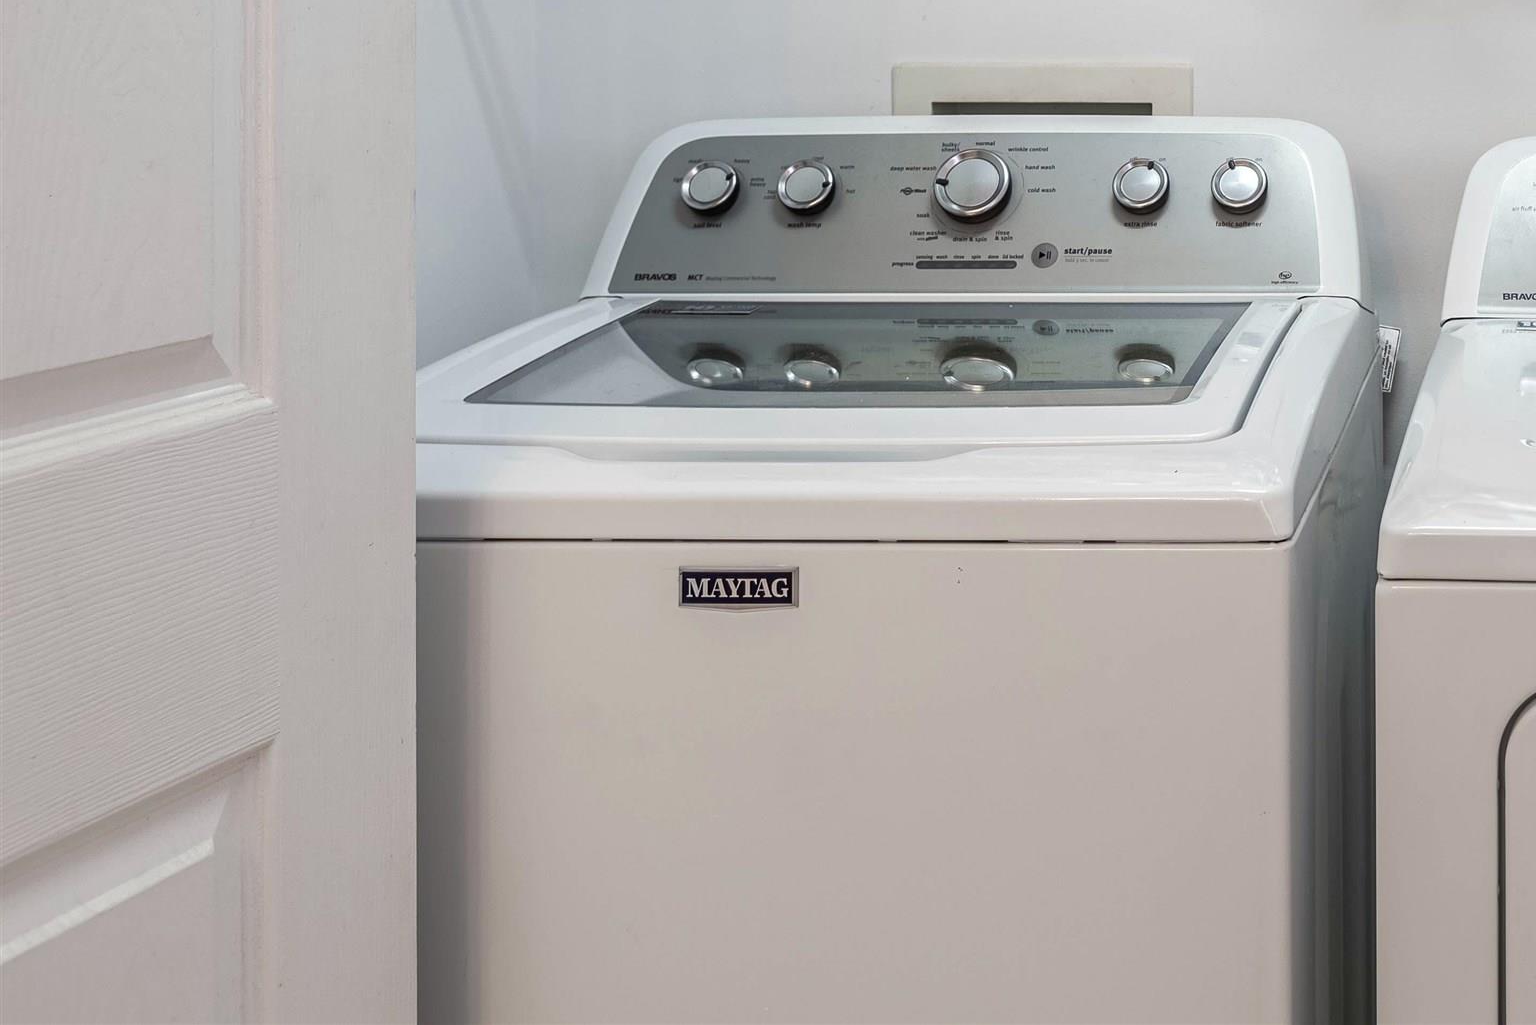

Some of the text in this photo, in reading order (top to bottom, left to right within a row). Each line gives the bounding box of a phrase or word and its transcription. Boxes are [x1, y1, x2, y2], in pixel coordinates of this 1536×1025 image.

[1064, 246, 1113, 256] start/pause
[634, 273, 677, 281] BRAVOS
[685, 577, 789, 598] MAYTAG
